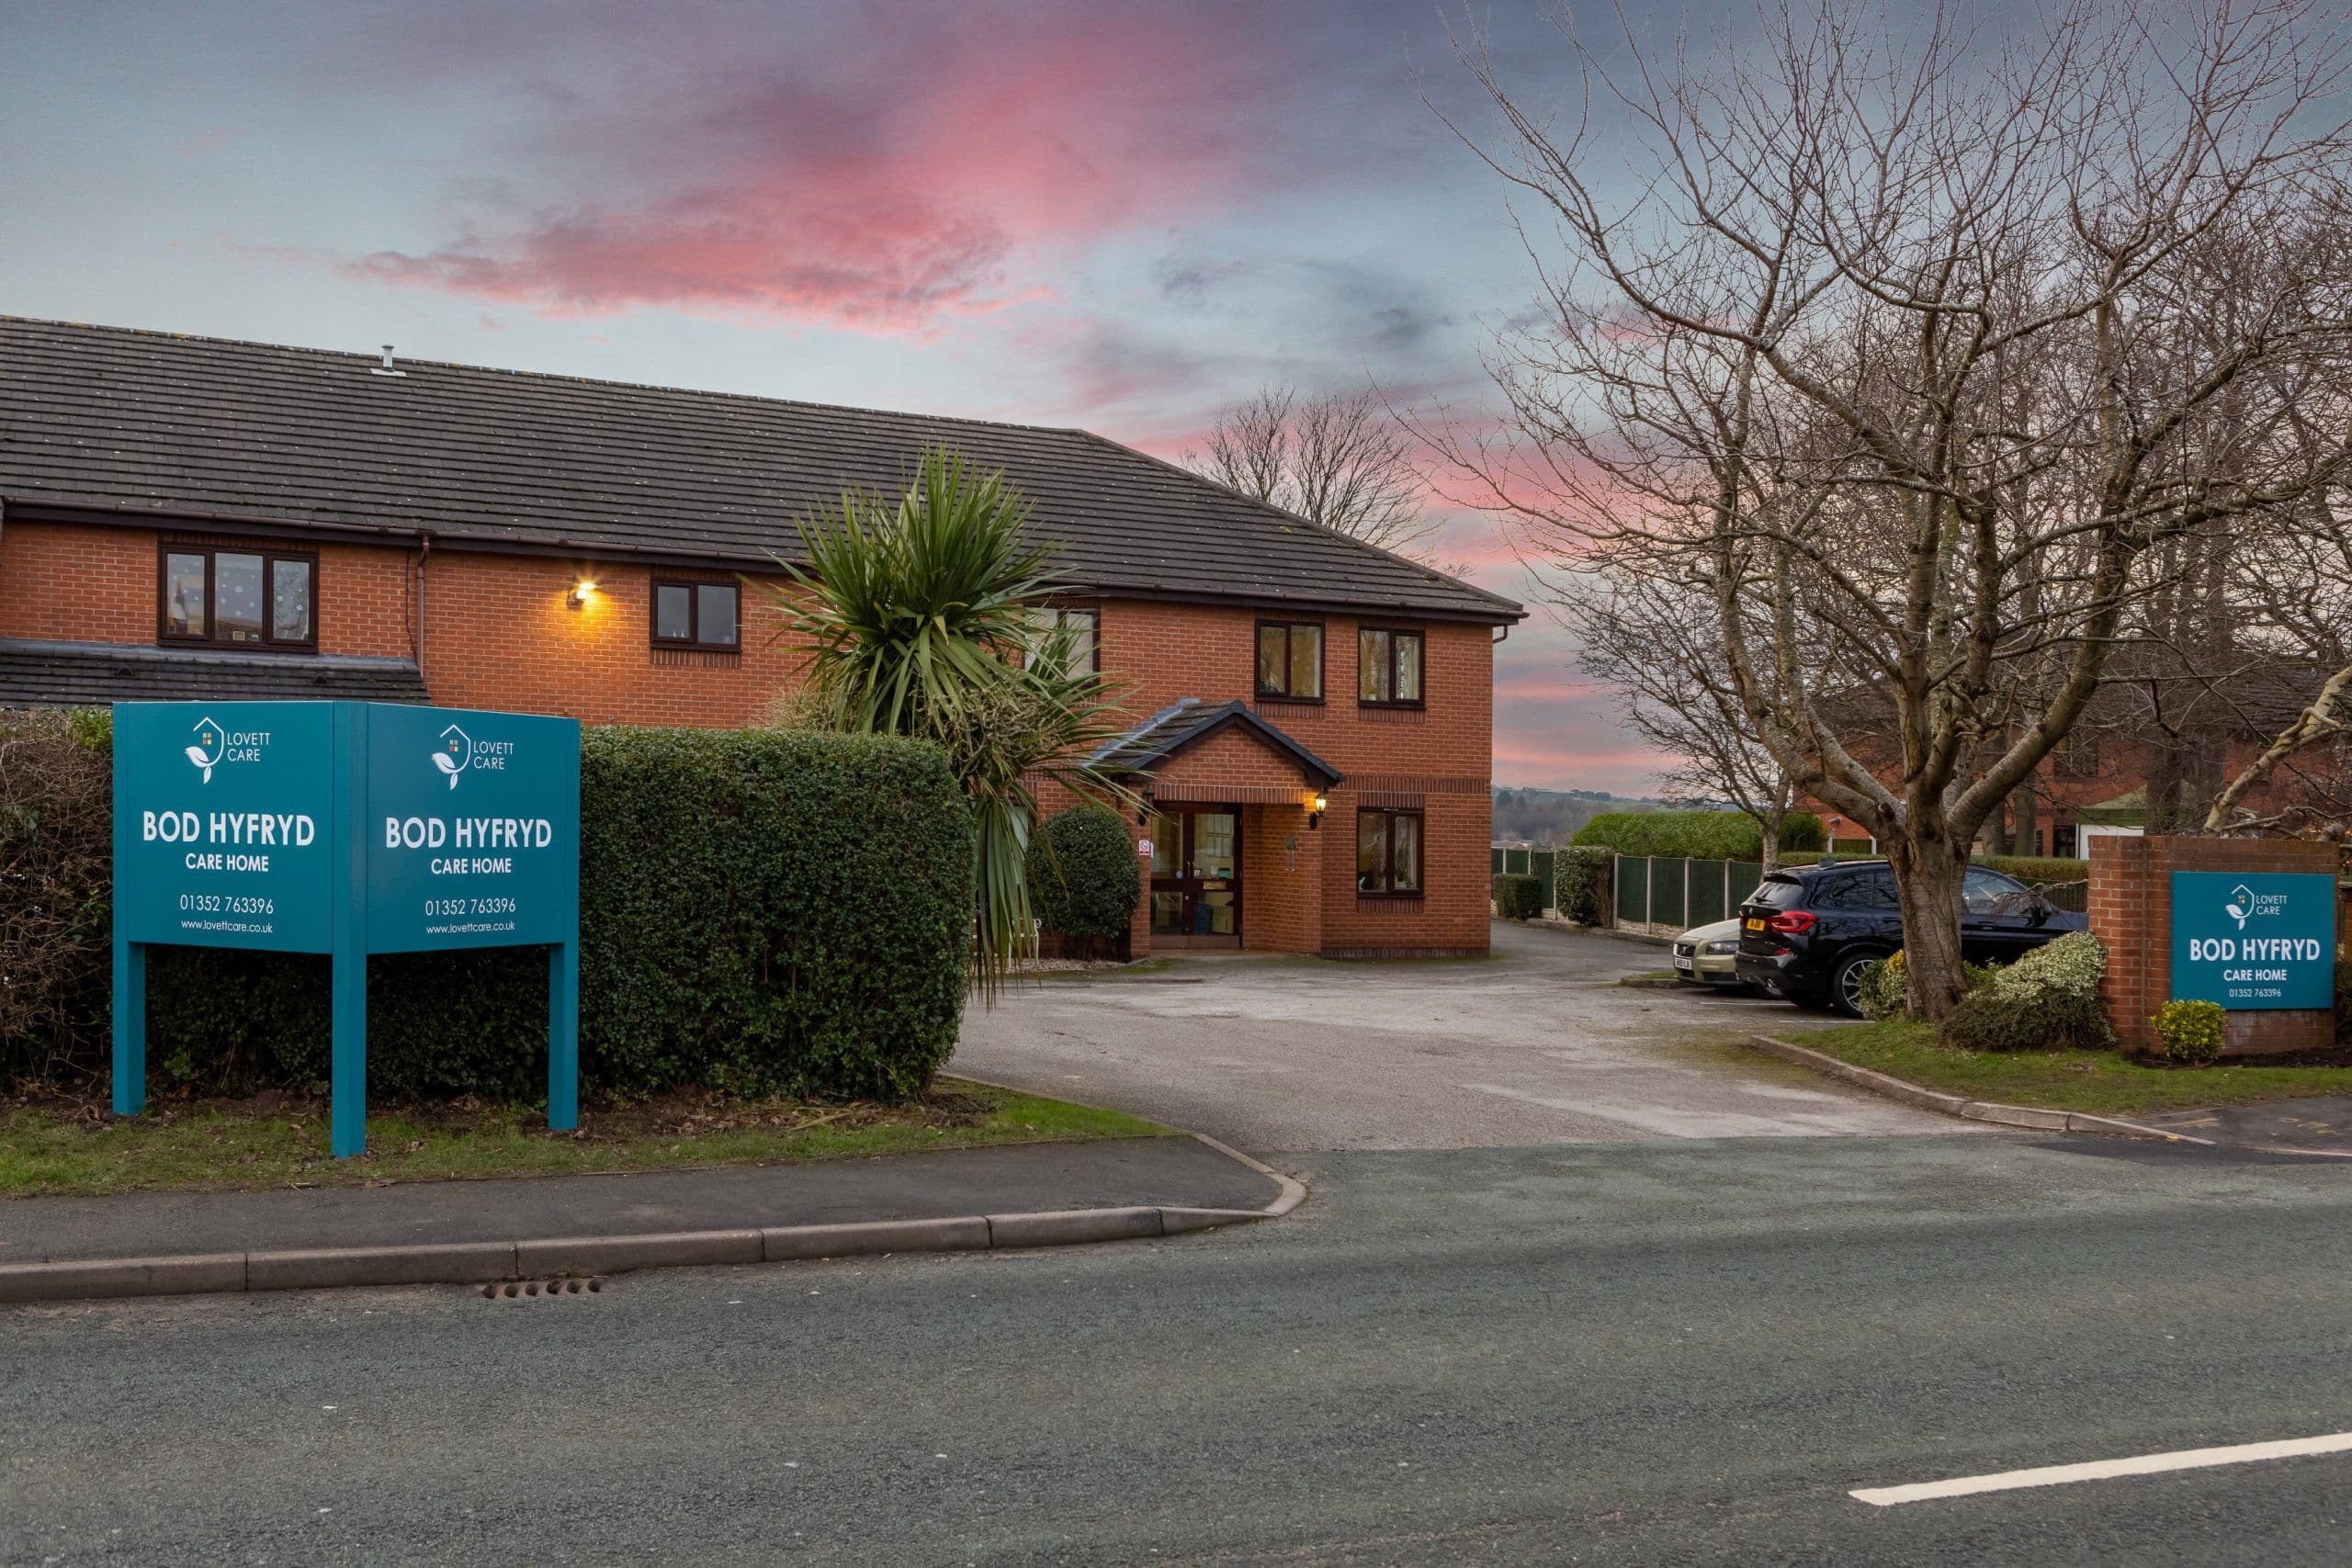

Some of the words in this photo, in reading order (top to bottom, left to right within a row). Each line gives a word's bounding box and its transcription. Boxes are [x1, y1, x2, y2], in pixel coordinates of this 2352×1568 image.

[227, 732, 271, 746] LOVETT
[227, 748, 261, 761] CARE
[473, 740, 514, 755] LOVETT
[473, 755, 505, 770] CARE
[142, 810, 200, 842] BOD
[209, 812, 315, 846] HYFRYD
[385, 817, 447, 849] BOD
[456, 818, 552, 849] HYFRYD
[185, 852, 223, 871] CARE
[226, 854, 269, 873] HOME
[430, 858, 469, 874] CARE
[471, 857, 512, 874] HOME
[179, 894, 220, 912] 01352
[224, 896, 275, 915] 763396
[425, 899, 466, 917] 01352
[470, 897, 516, 914] 763396
[2256, 895, 2288, 905] LOVETT
[2256, 906, 2281, 916] CARE
[181, 919, 273, 934] www.lovettcare.co.uk
[425, 920, 515, 934] www.lovettcare.co.uk
[2189, 938, 2236, 962] BOD
[2242, 938, 2321, 961] HYFRYD
[2223, 969, 2253, 982] CARE
[2255, 969, 2288, 981] HOME
[2229, 988, 2253, 998] 01352
[2255, 988, 2282, 998] 763396
